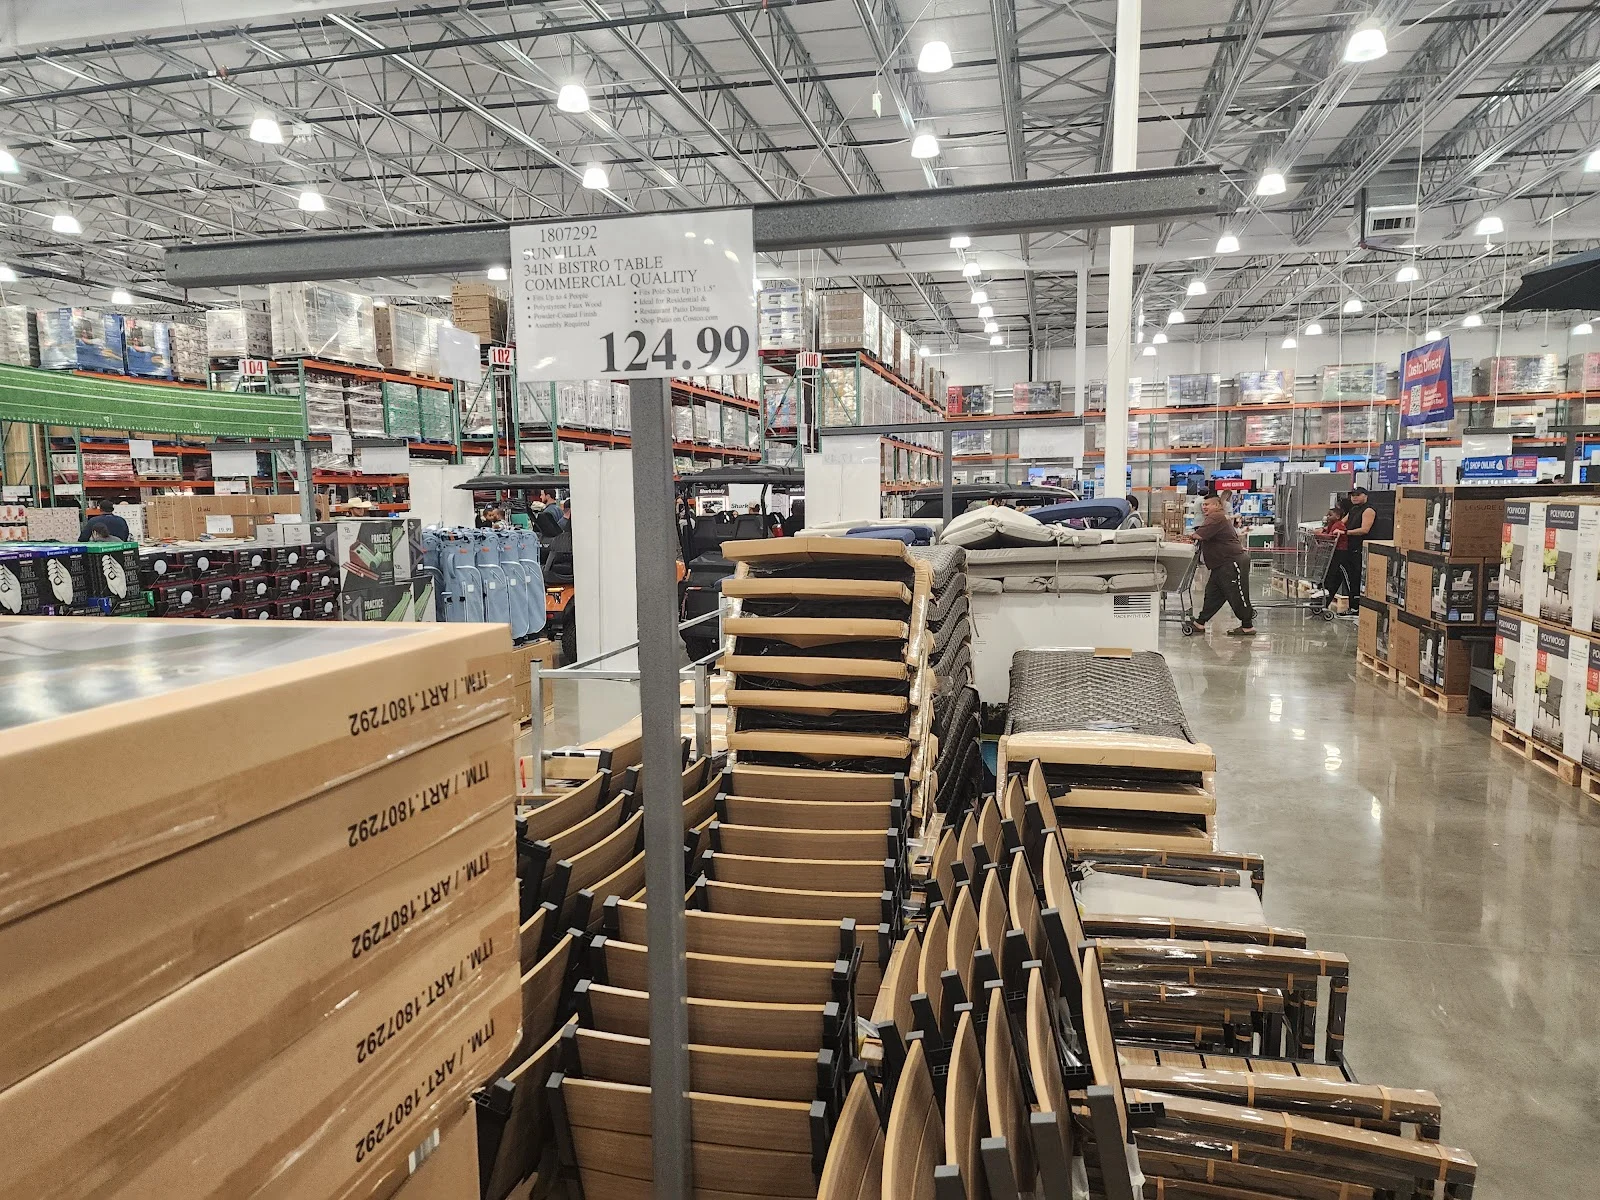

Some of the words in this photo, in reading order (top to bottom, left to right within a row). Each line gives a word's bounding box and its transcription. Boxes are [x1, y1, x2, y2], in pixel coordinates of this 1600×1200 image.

[540, 225, 598, 242] 1807292
[524, 245, 597, 261] SUNVILLA
[524, 263, 554, 276] 34IN
[559, 260, 610, 274] BISTRO
[614, 256, 664, 271] TABLE
[525, 274, 626, 292] COMMERCIAL
[630, 270, 698, 288] QUALITY
[569, 292, 588, 300] People
[666, 296, 699, 304] Residential
[640, 317, 654, 325] Shop
[492, 348, 511, 364] 102
[600, 325, 750, 372] 124.99
[242, 360, 264, 374] 104
[1470, 461, 1480, 470] SHOP
[1481, 460, 1496, 470] ONLINE
[1550, 510, 1575, 518] POLYWOOD
[371, 534, 391, 543] PRACTICE
[364, 598, 384, 610] PRACTICE
[1541, 633, 1565, 646] POLYWOOD
[460, 670, 488, 696] ITM.
[348, 682, 450, 736] ART.1807292
[461, 760, 490, 788] ITM.
[347, 778, 450, 848] ART.1807292
[462, 852, 490, 882] ITM.
[351, 875, 451, 959] ART.1807292
[466, 938, 493, 970] ITM.
[356, 966, 455, 1064] ART.1807292
[466, 1018, 495, 1053] ITM.
[355, 1052, 455, 1164] ART.1807292
